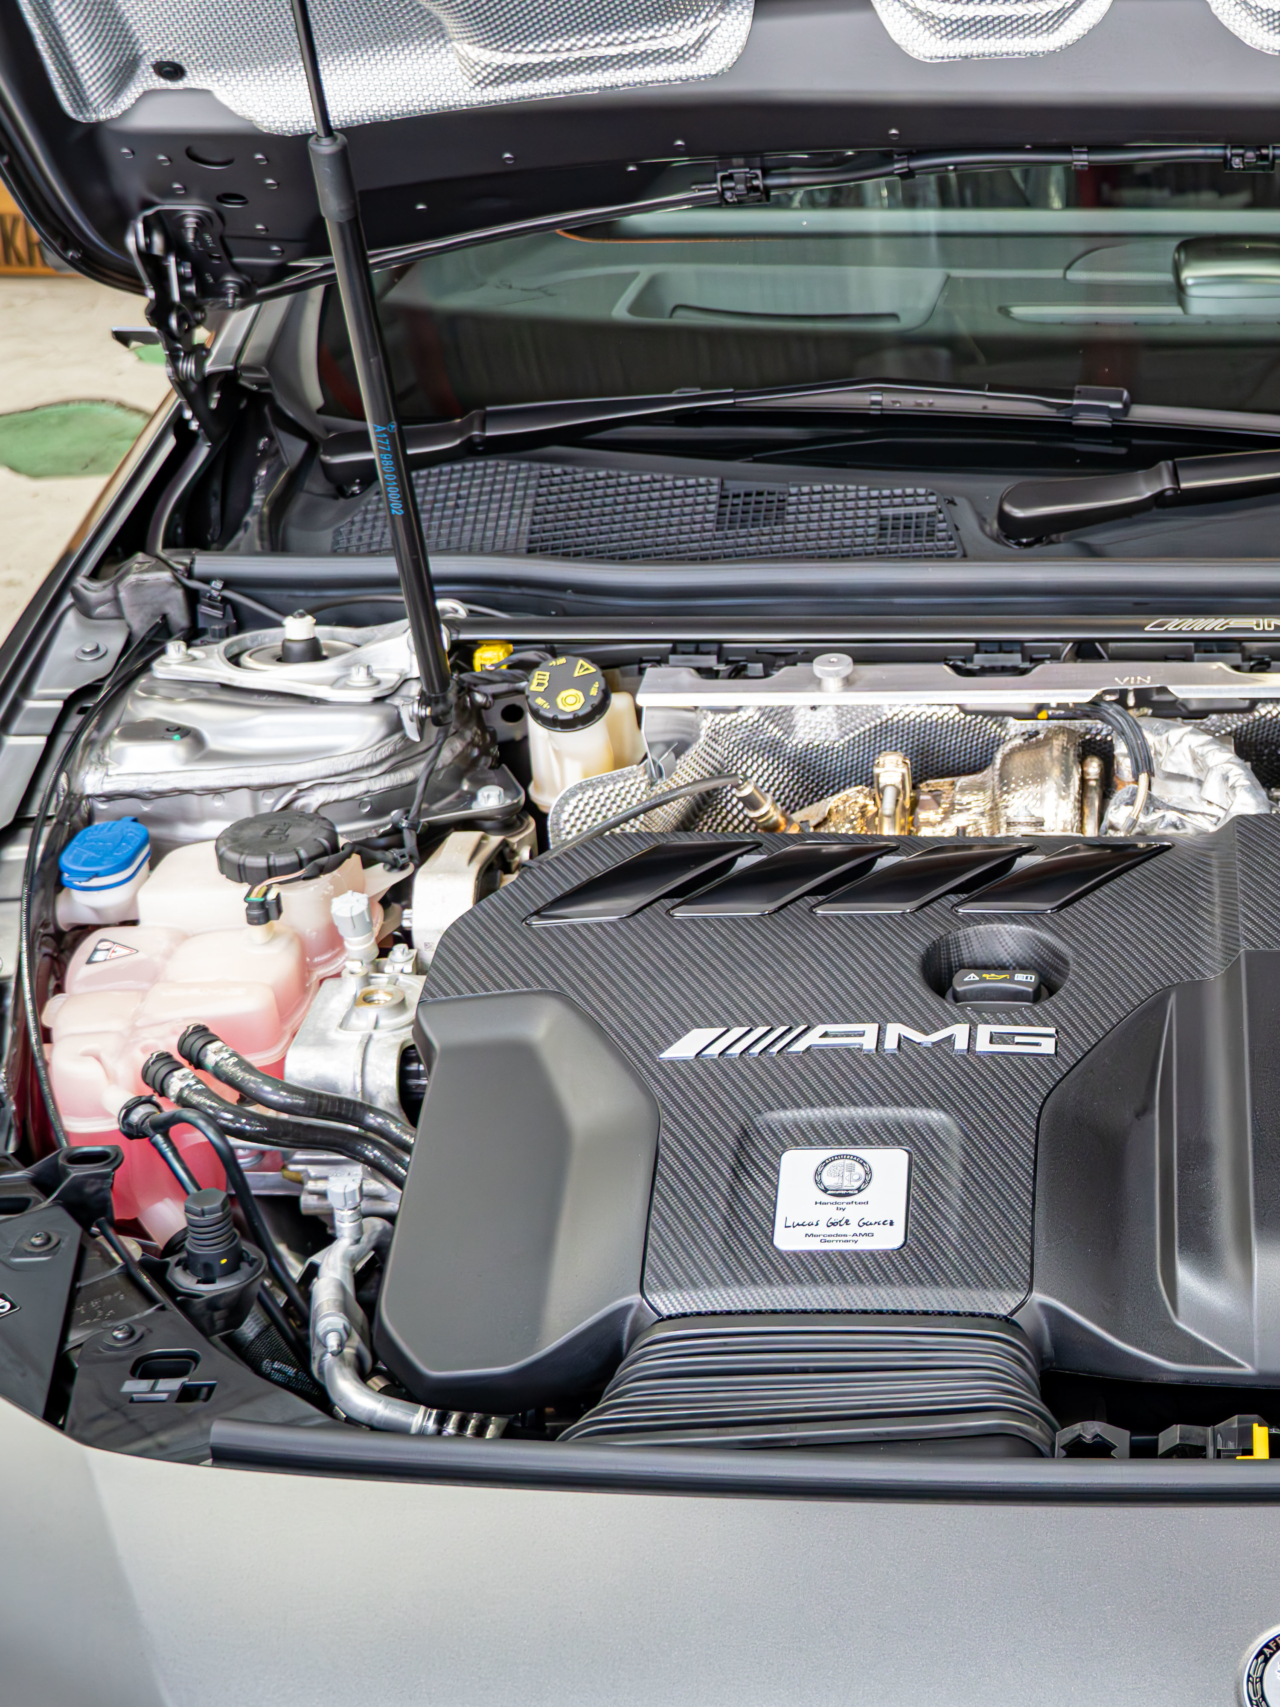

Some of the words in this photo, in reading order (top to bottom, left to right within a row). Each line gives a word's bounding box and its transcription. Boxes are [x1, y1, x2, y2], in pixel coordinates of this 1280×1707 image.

[380, 453, 396, 473] 980
[1114, 675, 1151, 686] VIN
[788, 1023, 1058, 1055] AMG
[784, 1216, 820, 1228] Lucas
